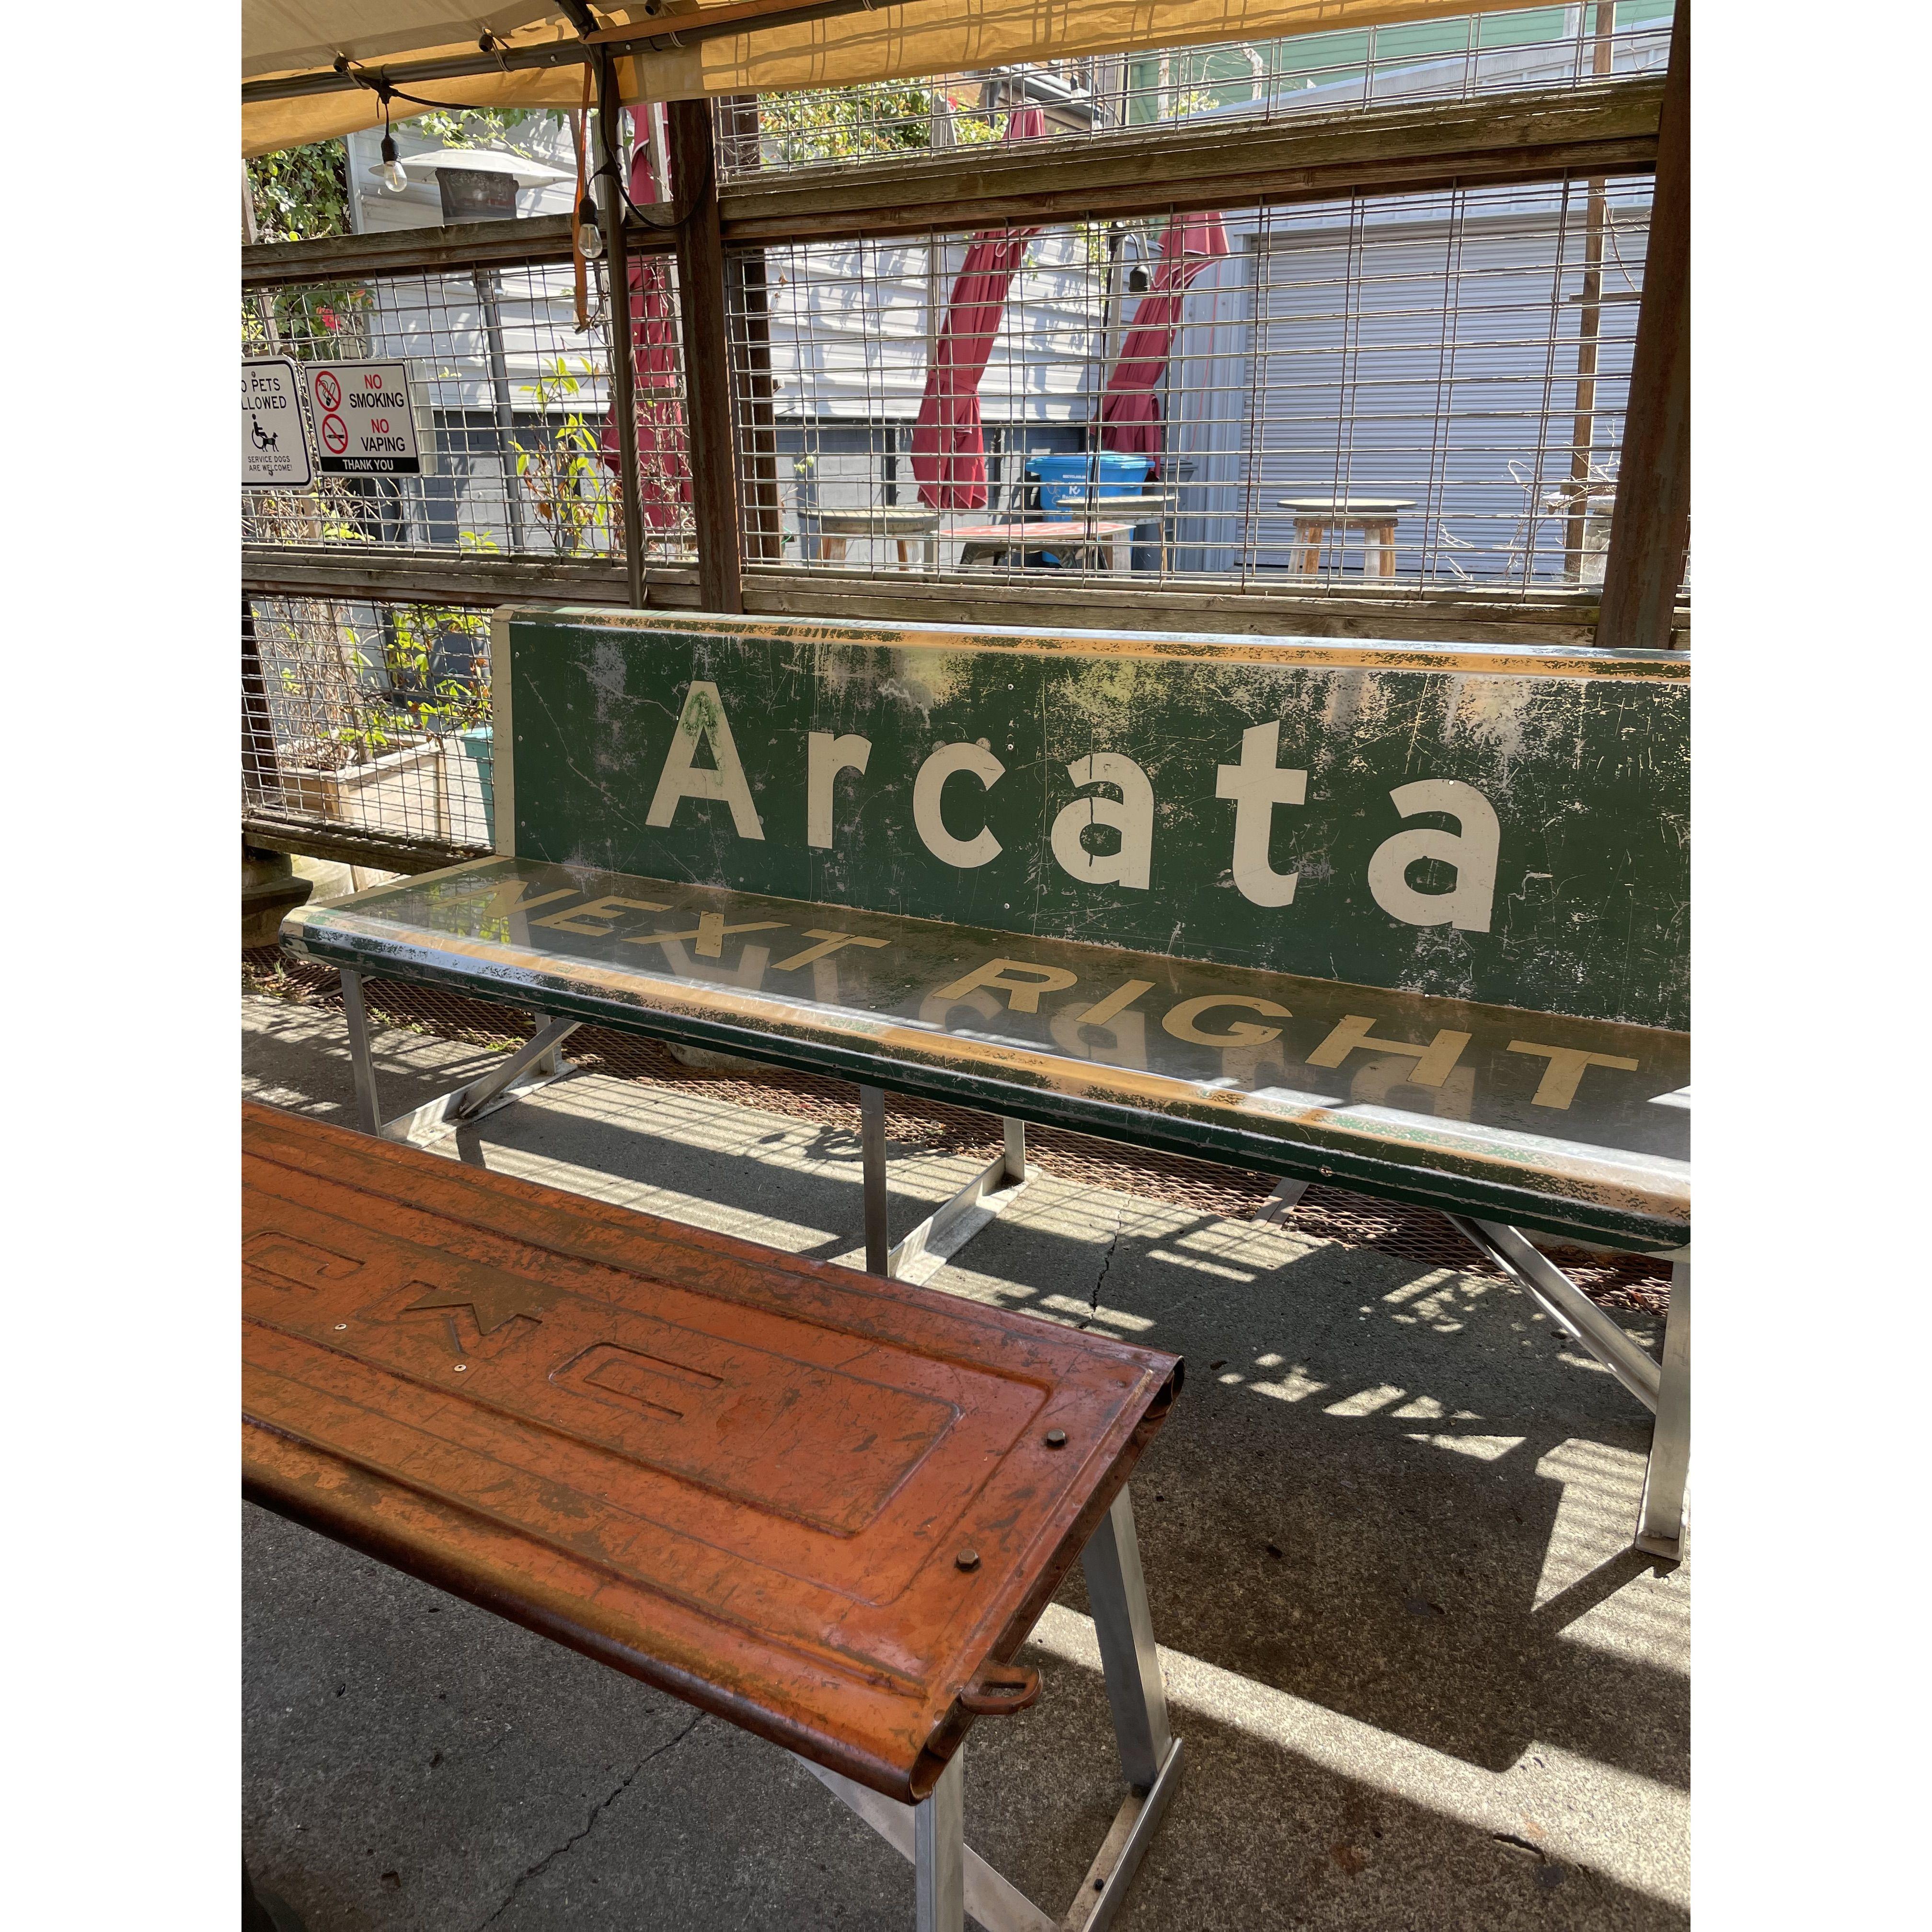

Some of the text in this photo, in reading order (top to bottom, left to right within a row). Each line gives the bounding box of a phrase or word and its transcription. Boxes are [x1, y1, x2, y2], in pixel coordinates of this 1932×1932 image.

[251, 378, 280, 392] PETS
[364, 374, 382, 389] NO
[349, 392, 404, 408] SMOKING
[371, 419, 389, 434] NO
[360, 437, 405, 452] VAPING
[343, 459, 393, 471] THANK YOU
[645, 680, 1500, 932] Arcata
[426, 880, 1639, 1109] NEXT RIGHT
